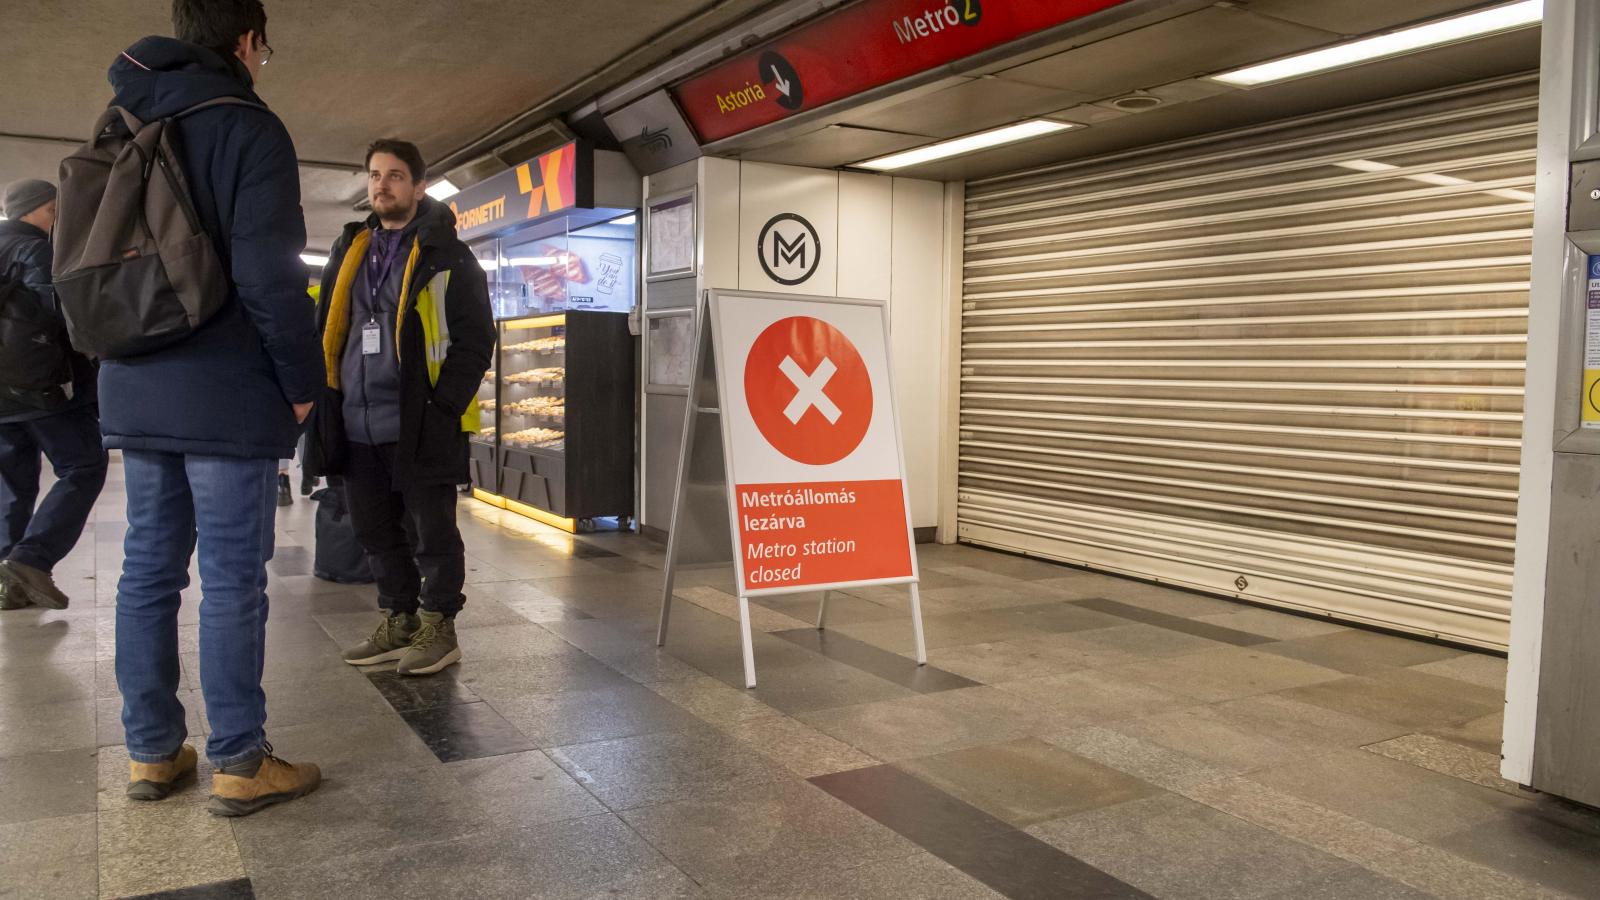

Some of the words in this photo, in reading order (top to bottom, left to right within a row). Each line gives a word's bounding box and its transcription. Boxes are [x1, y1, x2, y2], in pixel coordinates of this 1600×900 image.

[892, 0, 959, 44] Metró
[716, 81, 766, 114] Astoria
[457, 198, 505, 231] FORNETTI
[742, 487, 856, 508] Metróállomás
[744, 513, 806, 531] lezárva
[748, 542, 797, 560] Metro
[803, 537, 856, 556] station
[750, 563, 802, 583] closed
